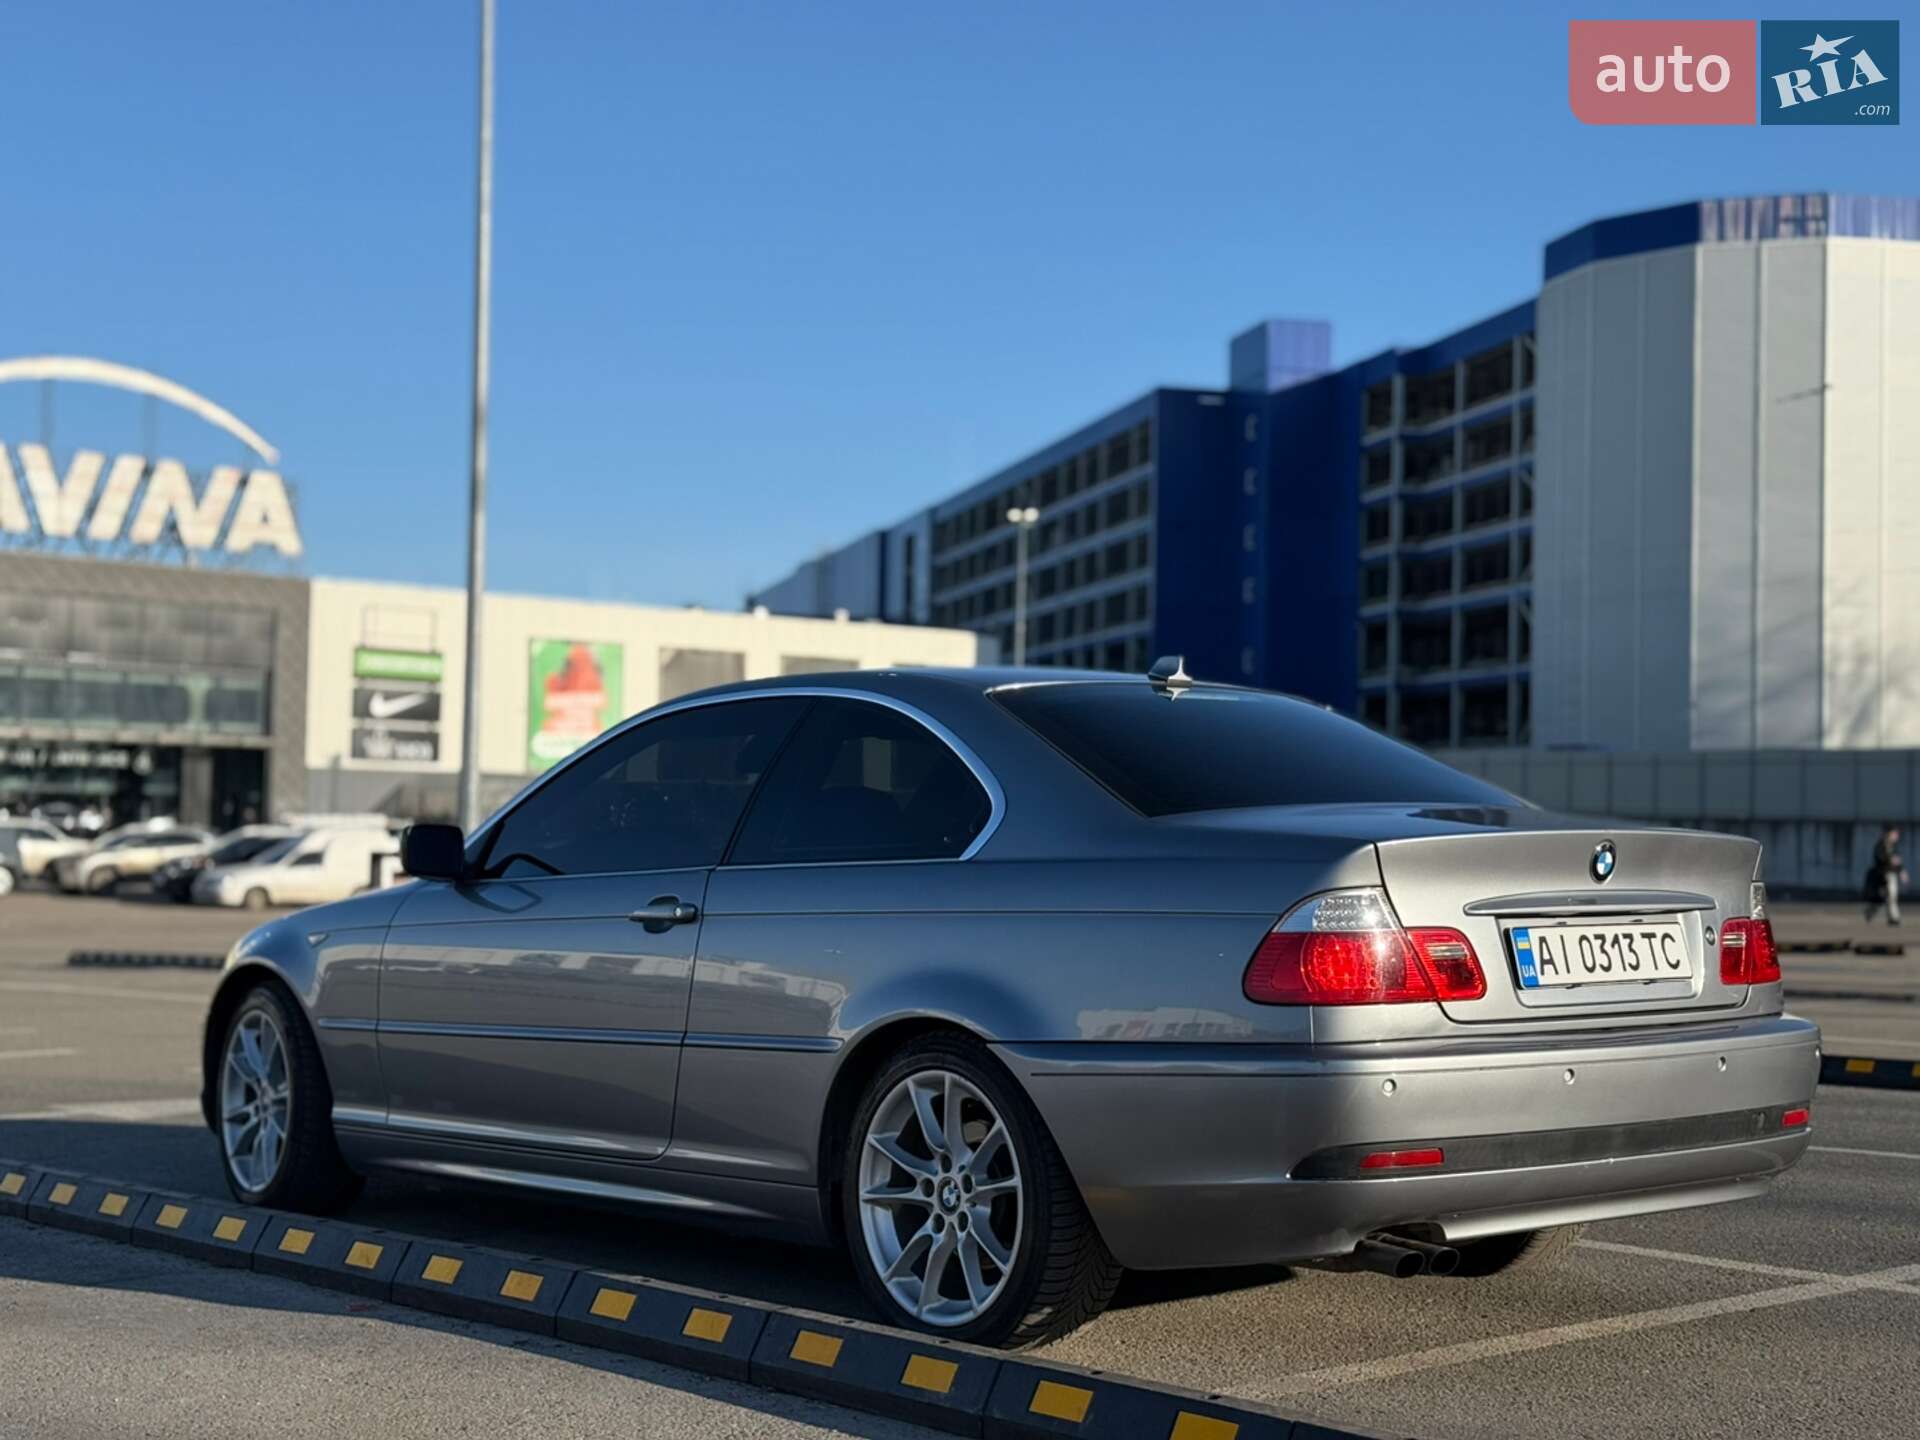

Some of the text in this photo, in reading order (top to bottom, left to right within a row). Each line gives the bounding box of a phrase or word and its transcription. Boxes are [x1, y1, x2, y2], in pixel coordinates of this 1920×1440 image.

[1538, 931, 1681, 976] AI 0313 TC
[1521, 964, 1537, 977] UA
